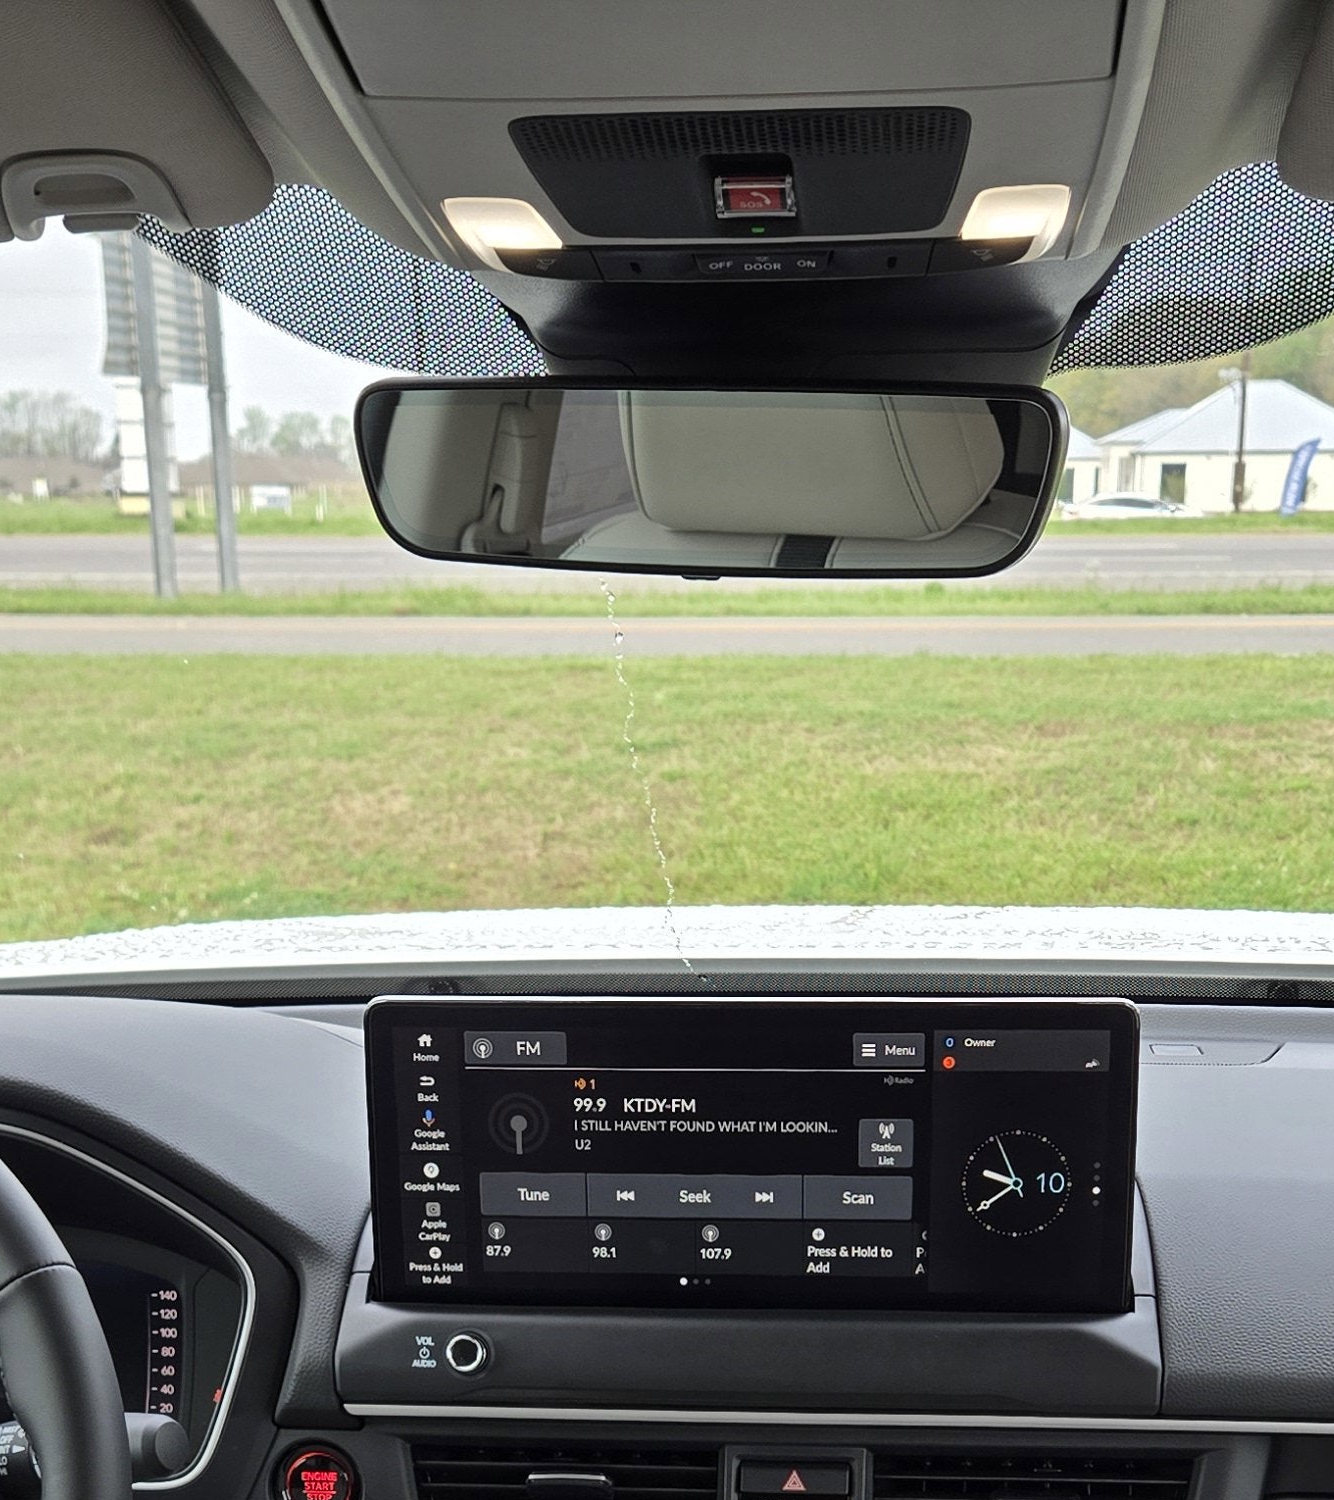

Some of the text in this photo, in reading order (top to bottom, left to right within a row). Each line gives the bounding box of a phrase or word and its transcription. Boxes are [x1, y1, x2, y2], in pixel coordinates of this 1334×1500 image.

[739, 200, 764, 209] SOS
[709, 258, 816, 272] OFF DOOR ON
[964, 1037, 996, 1048] Owner
[516, 1041, 542, 1057] FM
[884, 1044, 916, 1057] Menu
[413, 1053, 440, 1063] Home
[417, 1093, 440, 1103] Back
[573, 1098, 697, 1113] 99.9 KTDY-FM
[580, 1120, 612, 1132] STILL
[614, 1120, 668, 1132] HAVEN'T
[670, 1120, 715, 1133] FOUND
[717, 1121, 757, 1133] WHAT
[758, 1121, 779, 1133] I'M
[780, 1121, 838, 1133] LOOKIN...
[414, 1130, 446, 1141] Google
[411, 1142, 450, 1152] Assistant
[575, 1139, 592, 1151] U2
[870, 1142, 903, 1153] Station
[878, 1155, 895, 1167] List
[404, 1182, 461, 1194] Google Maps
[1036, 1172, 1065, 1195] 10
[517, 1188, 551, 1202] Tune
[679, 1190, 711, 1204] Seek
[842, 1191, 875, 1205] Scan
[421, 1220, 448, 1231] Apple
[418, 1232, 451, 1243] CarPlay
[485, 1245, 512, 1257] 87.9
[592, 1247, 617, 1259] 98.1
[700, 1248, 732, 1260] 107.9
[807, 1245, 893, 1258] Press & Hold to
[409, 1263, 464, 1272] Press & Hold
[807, 1262, 830, 1274] Add
[422, 1276, 452, 1285] to Add
[158, 1290, 178, 1302] 140
[159, 1308, 178, 1320] 120
[159, 1327, 178, 1339] 100
[415, 1336, 435, 1347] VOL
[160, 1346, 176, 1358] 80
[411, 1359, 437, 1368] AUDIO
[160, 1365, 176, 1377] 60
[159, 1384, 175, 1395] 40
[159, 1402, 174, 1414] 20
[300, 1471, 338, 1483] ENGINE
[304, 1481, 336, 1493] START
